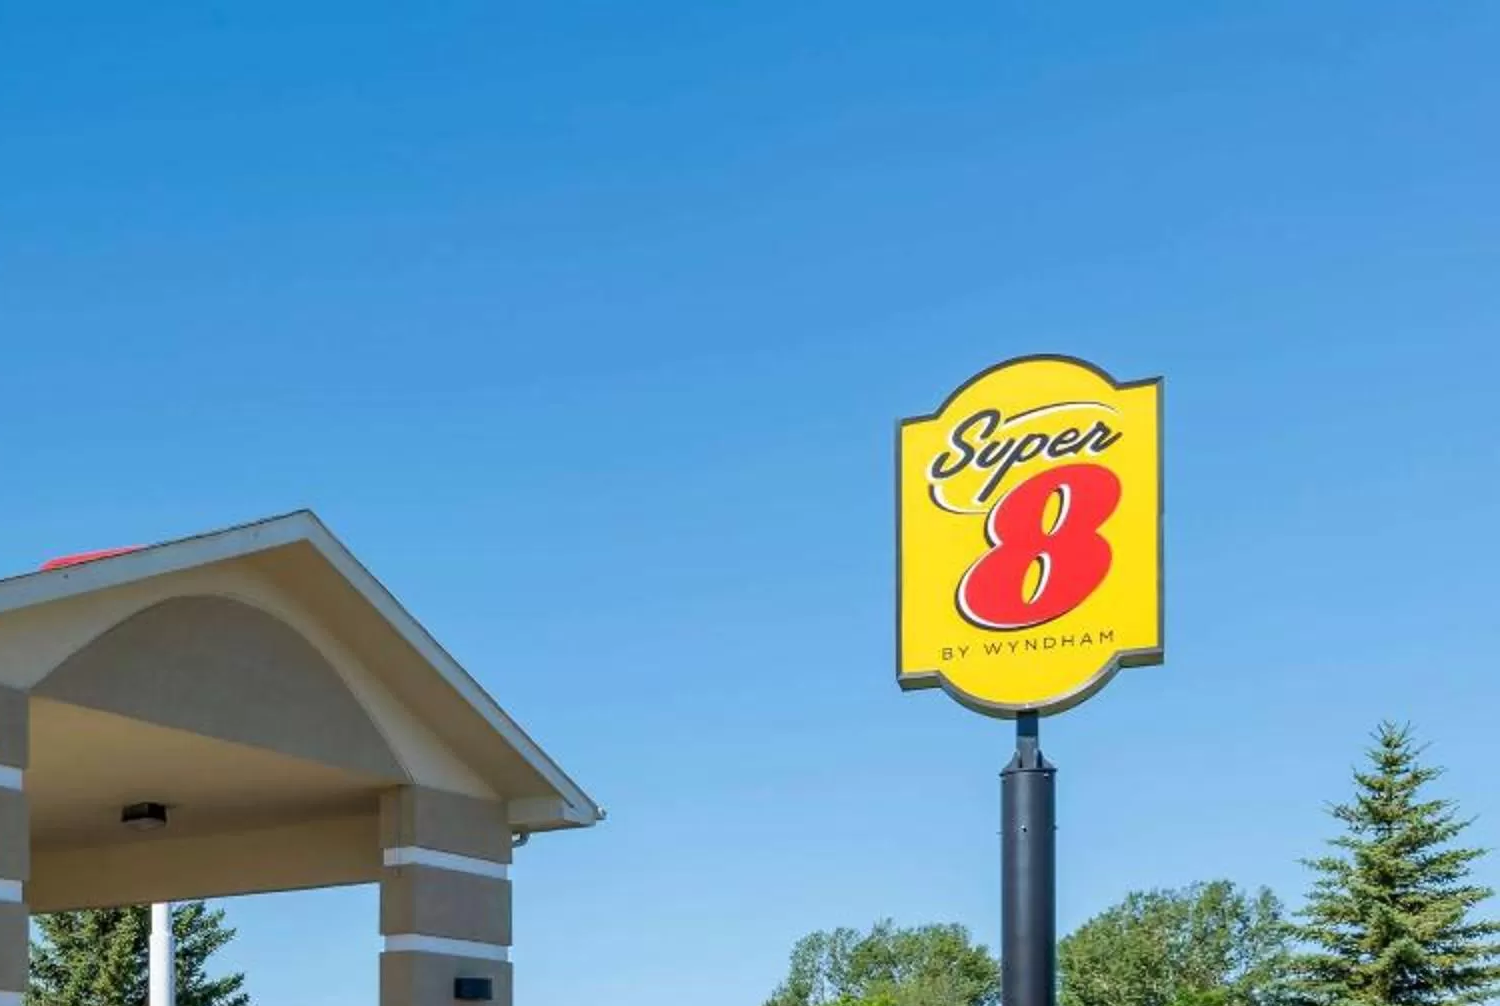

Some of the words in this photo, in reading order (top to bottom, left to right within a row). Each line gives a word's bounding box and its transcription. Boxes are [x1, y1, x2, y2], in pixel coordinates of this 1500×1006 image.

[929, 408, 1123, 504] Super
[954, 463, 1123, 633] 8
[941, 645, 970, 661] BY
[983, 629, 1115, 656] WYNDHAM
